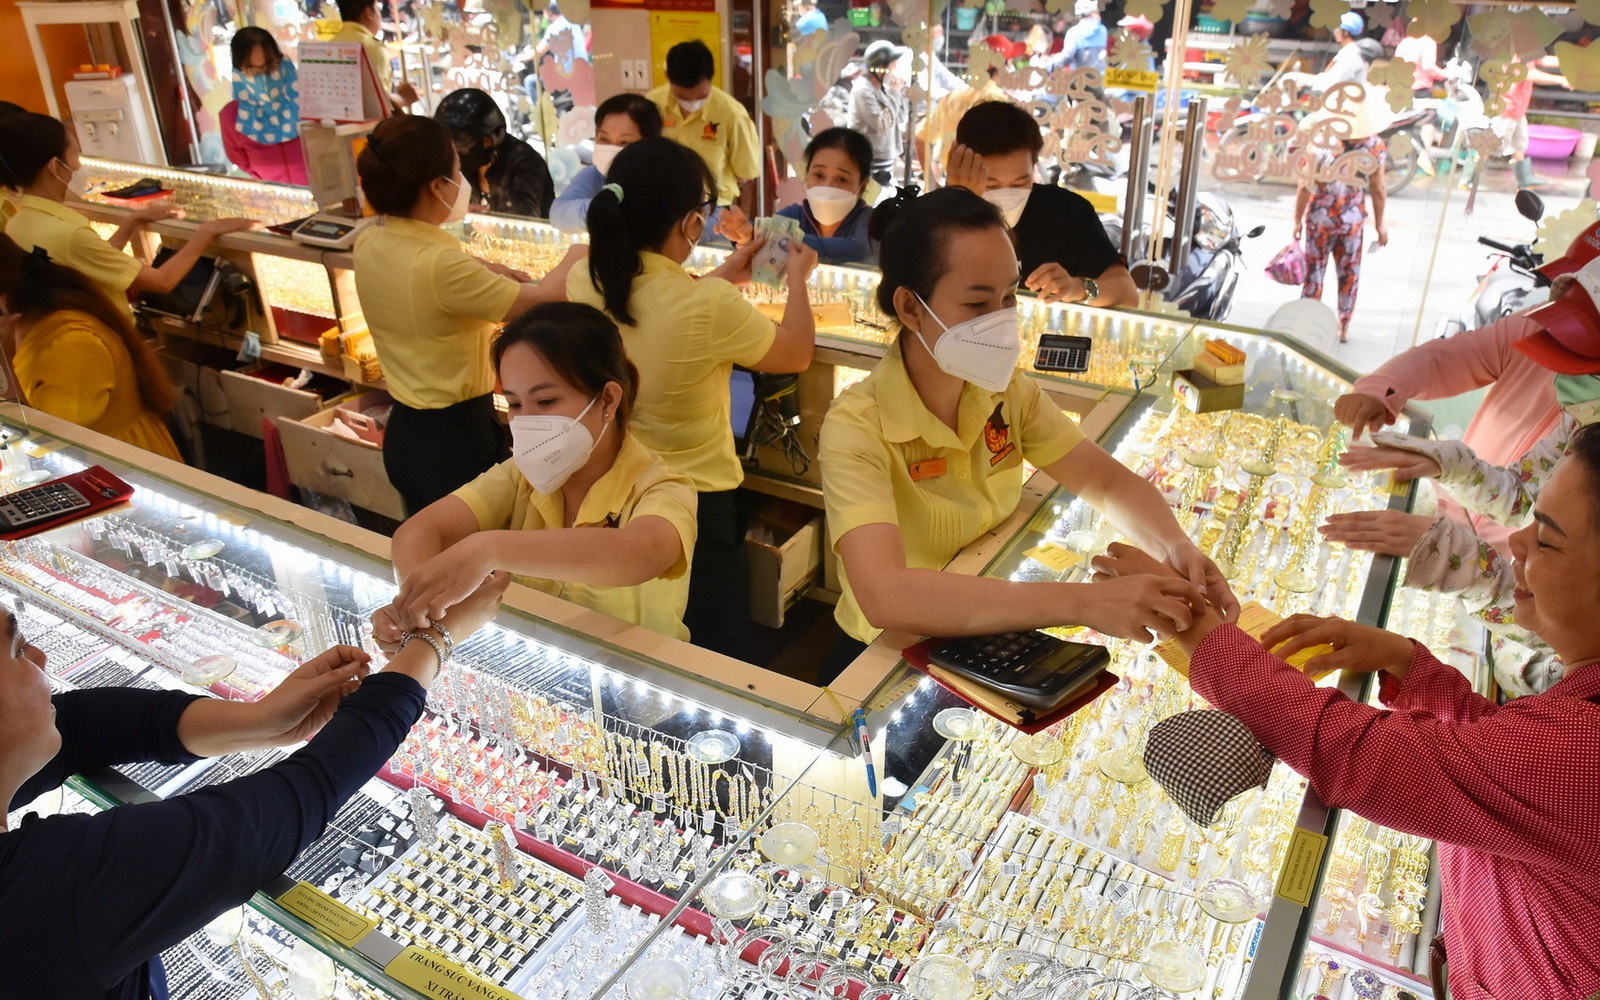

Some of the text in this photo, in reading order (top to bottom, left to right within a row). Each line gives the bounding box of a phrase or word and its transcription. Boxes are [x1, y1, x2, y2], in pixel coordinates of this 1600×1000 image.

[409, 951, 443, 973] TRANG
[466, 979, 498, 1000] VÀNG
[424, 980, 439, 992] XI
